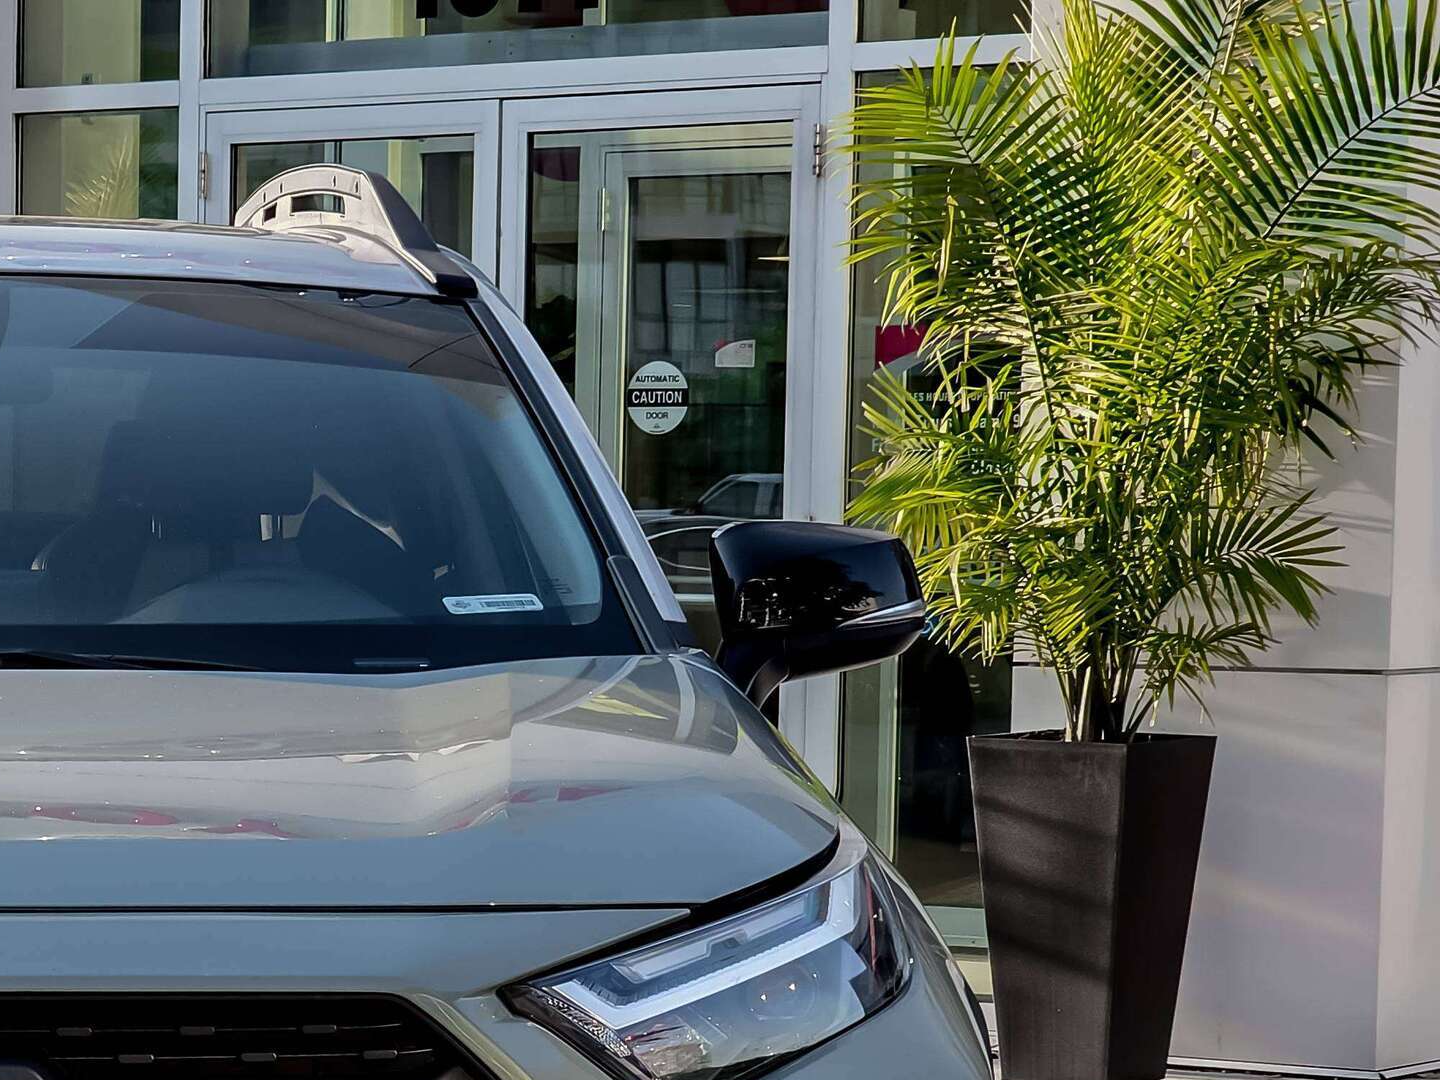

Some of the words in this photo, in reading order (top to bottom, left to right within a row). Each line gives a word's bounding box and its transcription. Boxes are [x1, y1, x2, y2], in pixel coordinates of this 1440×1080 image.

[635, 374, 680, 383] AUTOMATIC
[631, 390, 682, 404] CAUTION
[645, 411, 669, 420] DOOR
